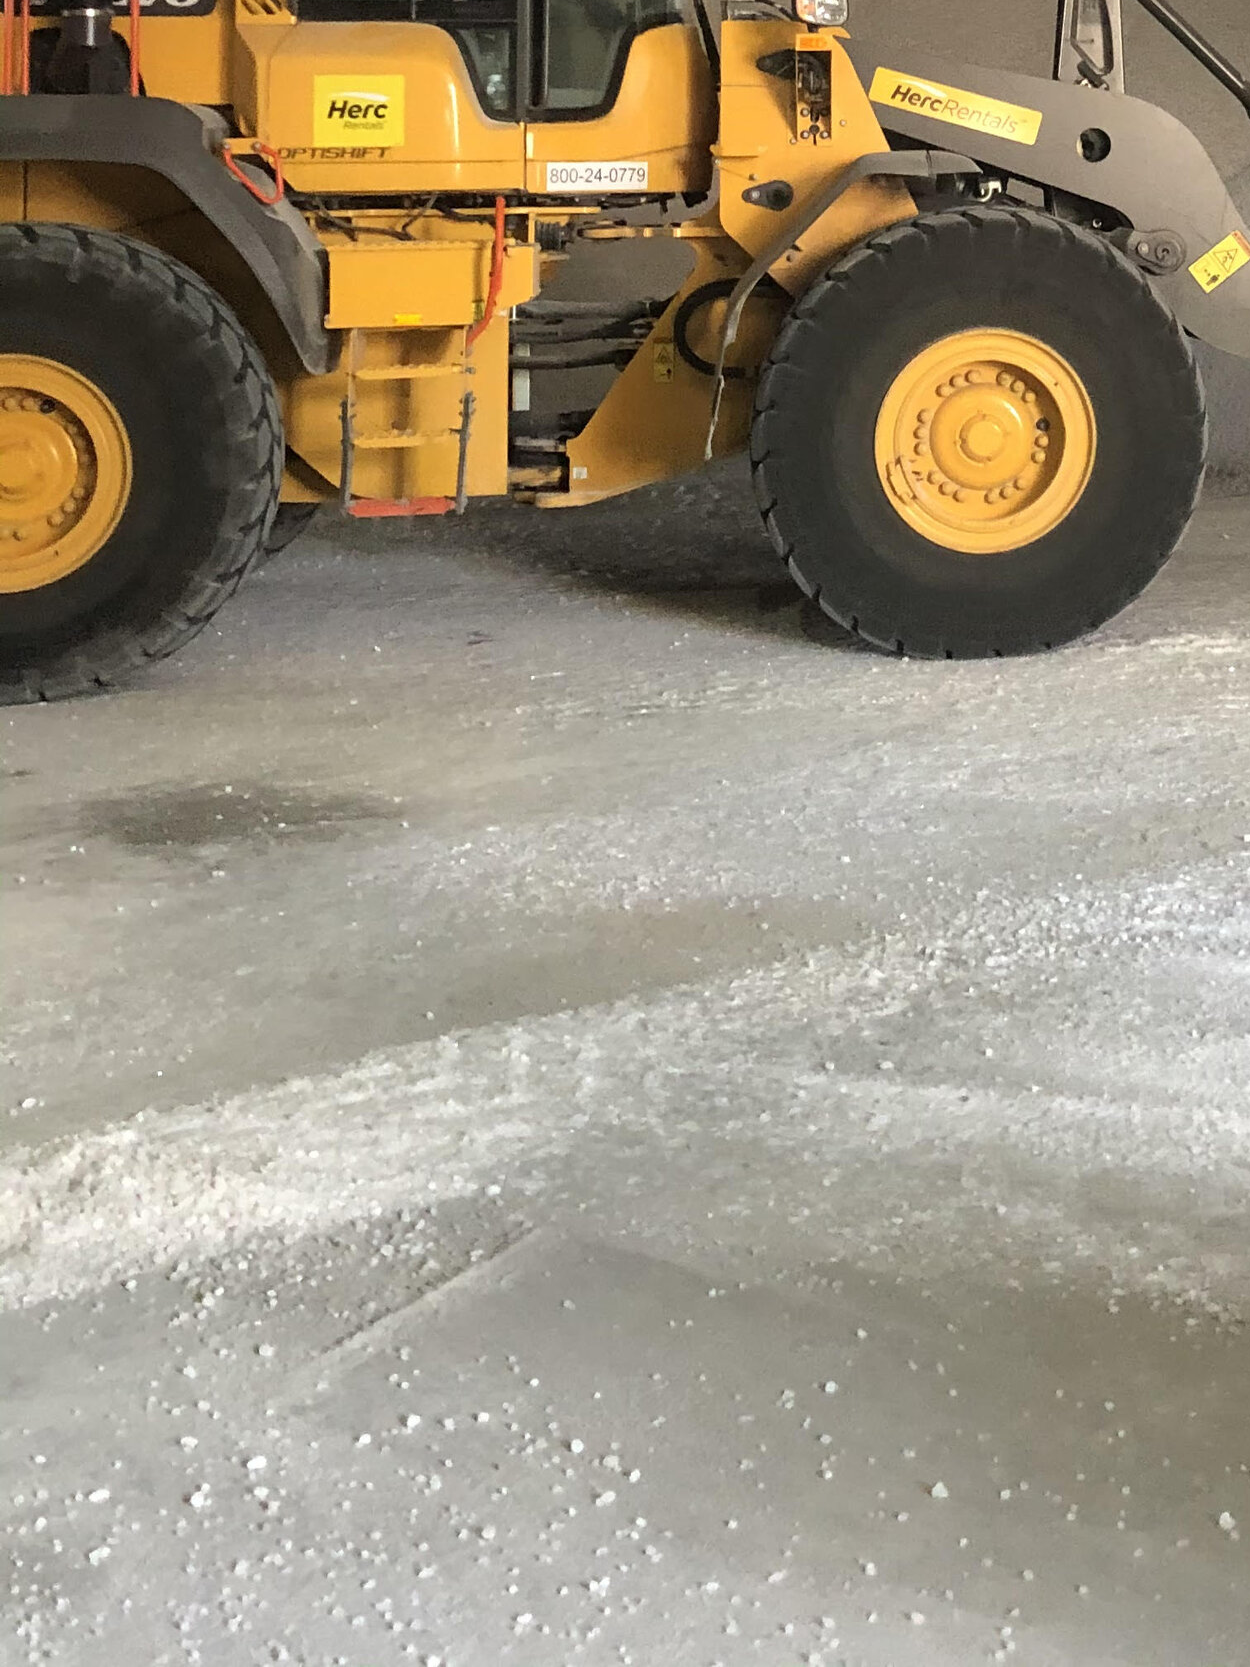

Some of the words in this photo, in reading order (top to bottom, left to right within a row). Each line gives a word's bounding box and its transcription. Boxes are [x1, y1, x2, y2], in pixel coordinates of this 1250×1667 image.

[327, 99, 389, 119] Herc
[890, 85, 1018, 134] HercRentals
[343, 121, 385, 131] Rentals
[277, 146, 392, 160] OPTISHIFT
[549, 167, 646, 184] 800-24-0779
